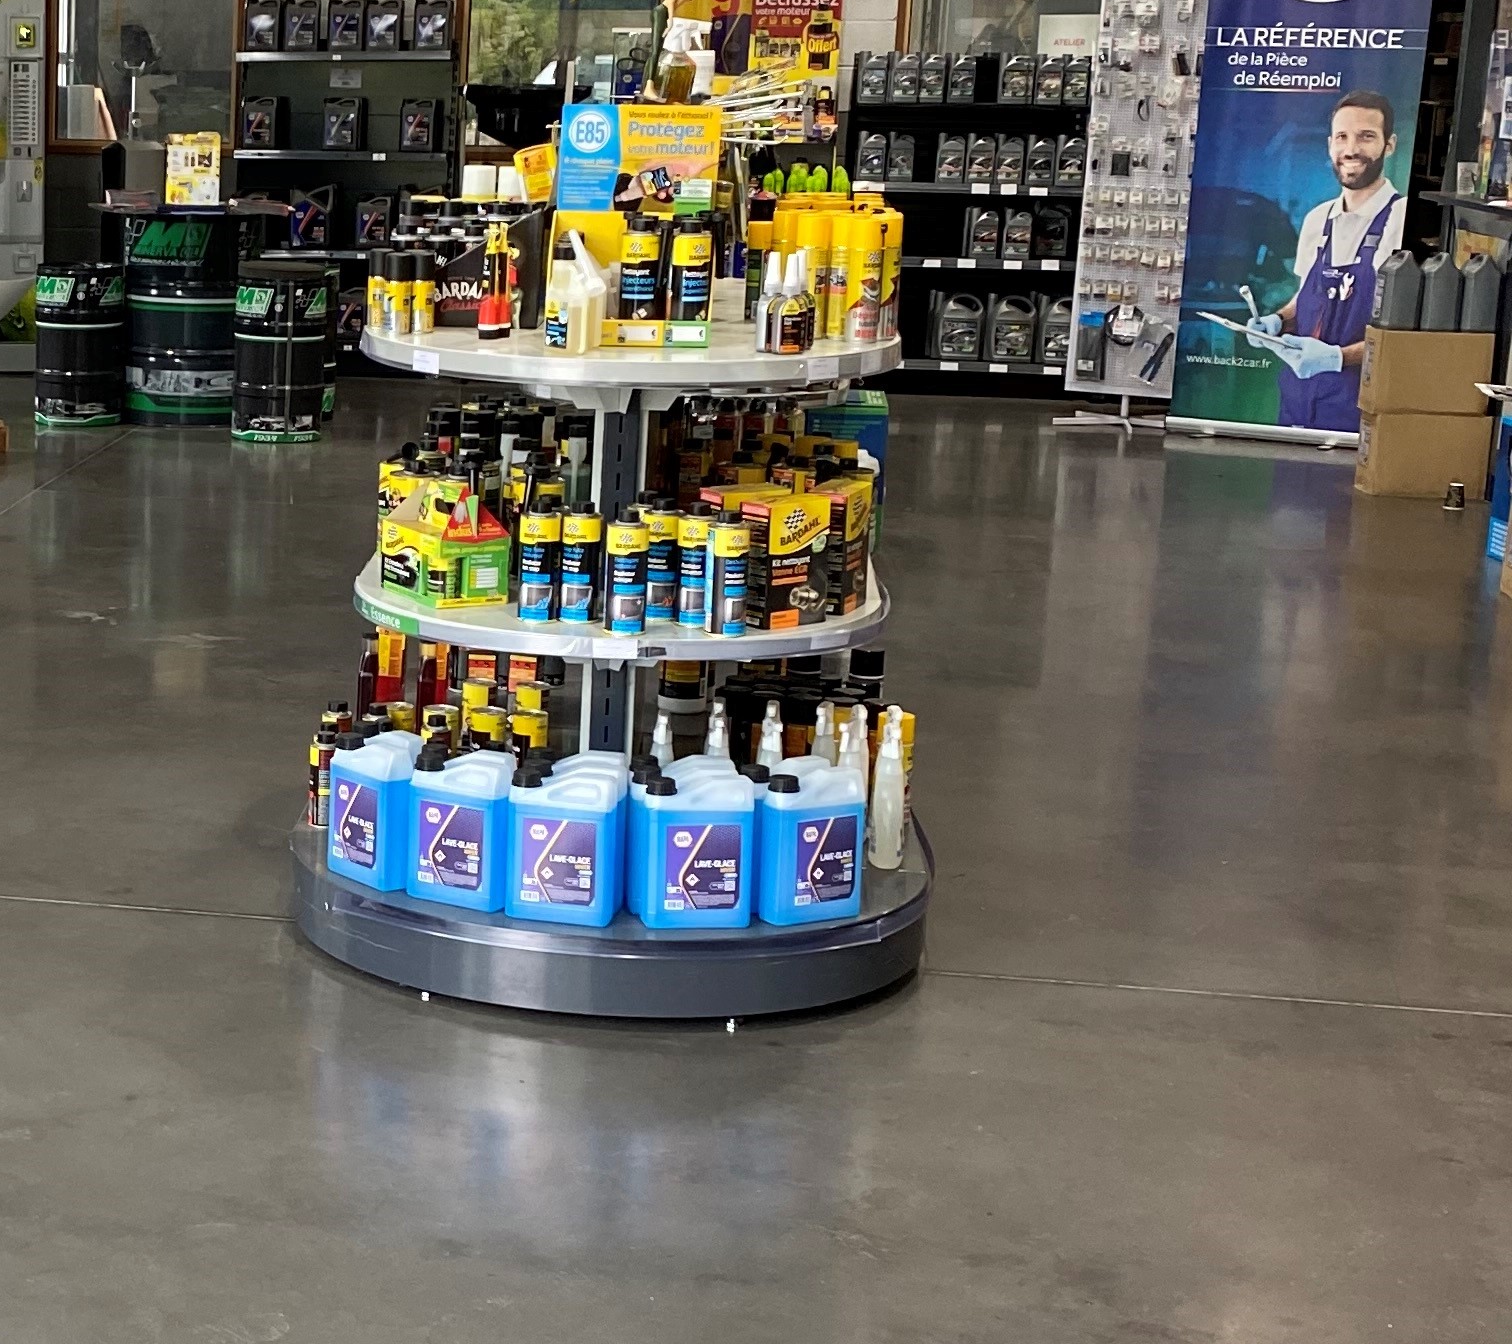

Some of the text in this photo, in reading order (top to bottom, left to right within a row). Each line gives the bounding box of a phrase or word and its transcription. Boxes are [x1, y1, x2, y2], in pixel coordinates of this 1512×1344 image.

[755, 7, 811, 17] votre moteur
[1054, 38, 1086, 47] ATELIER
[1217, 22, 1405, 49] LA RÉFÉRENCE
[808, 37, 837, 53] Offert
[1228, 52, 1308, 67] de la Pièce
[1233, 71, 1341, 90] de Réemploi
[575, 120, 605, 144] E85
[628, 121, 705, 141] Protégez
[622, 277, 655, 285] Injecteurs
[1186, 354, 1272, 369] www.back2car.fr
[254, 434, 277, 442] 1934
[779, 517, 821, 547] BARDAHL
[370, 605, 401, 629] Essence
[441, 837, 479, 850] LAVE-GLACE
[549, 854, 592, 865] LAVE-GLACE
[820, 849, 853, 862] LAVE-GLACE
[694, 859, 736, 869] LAVE-GLACE
